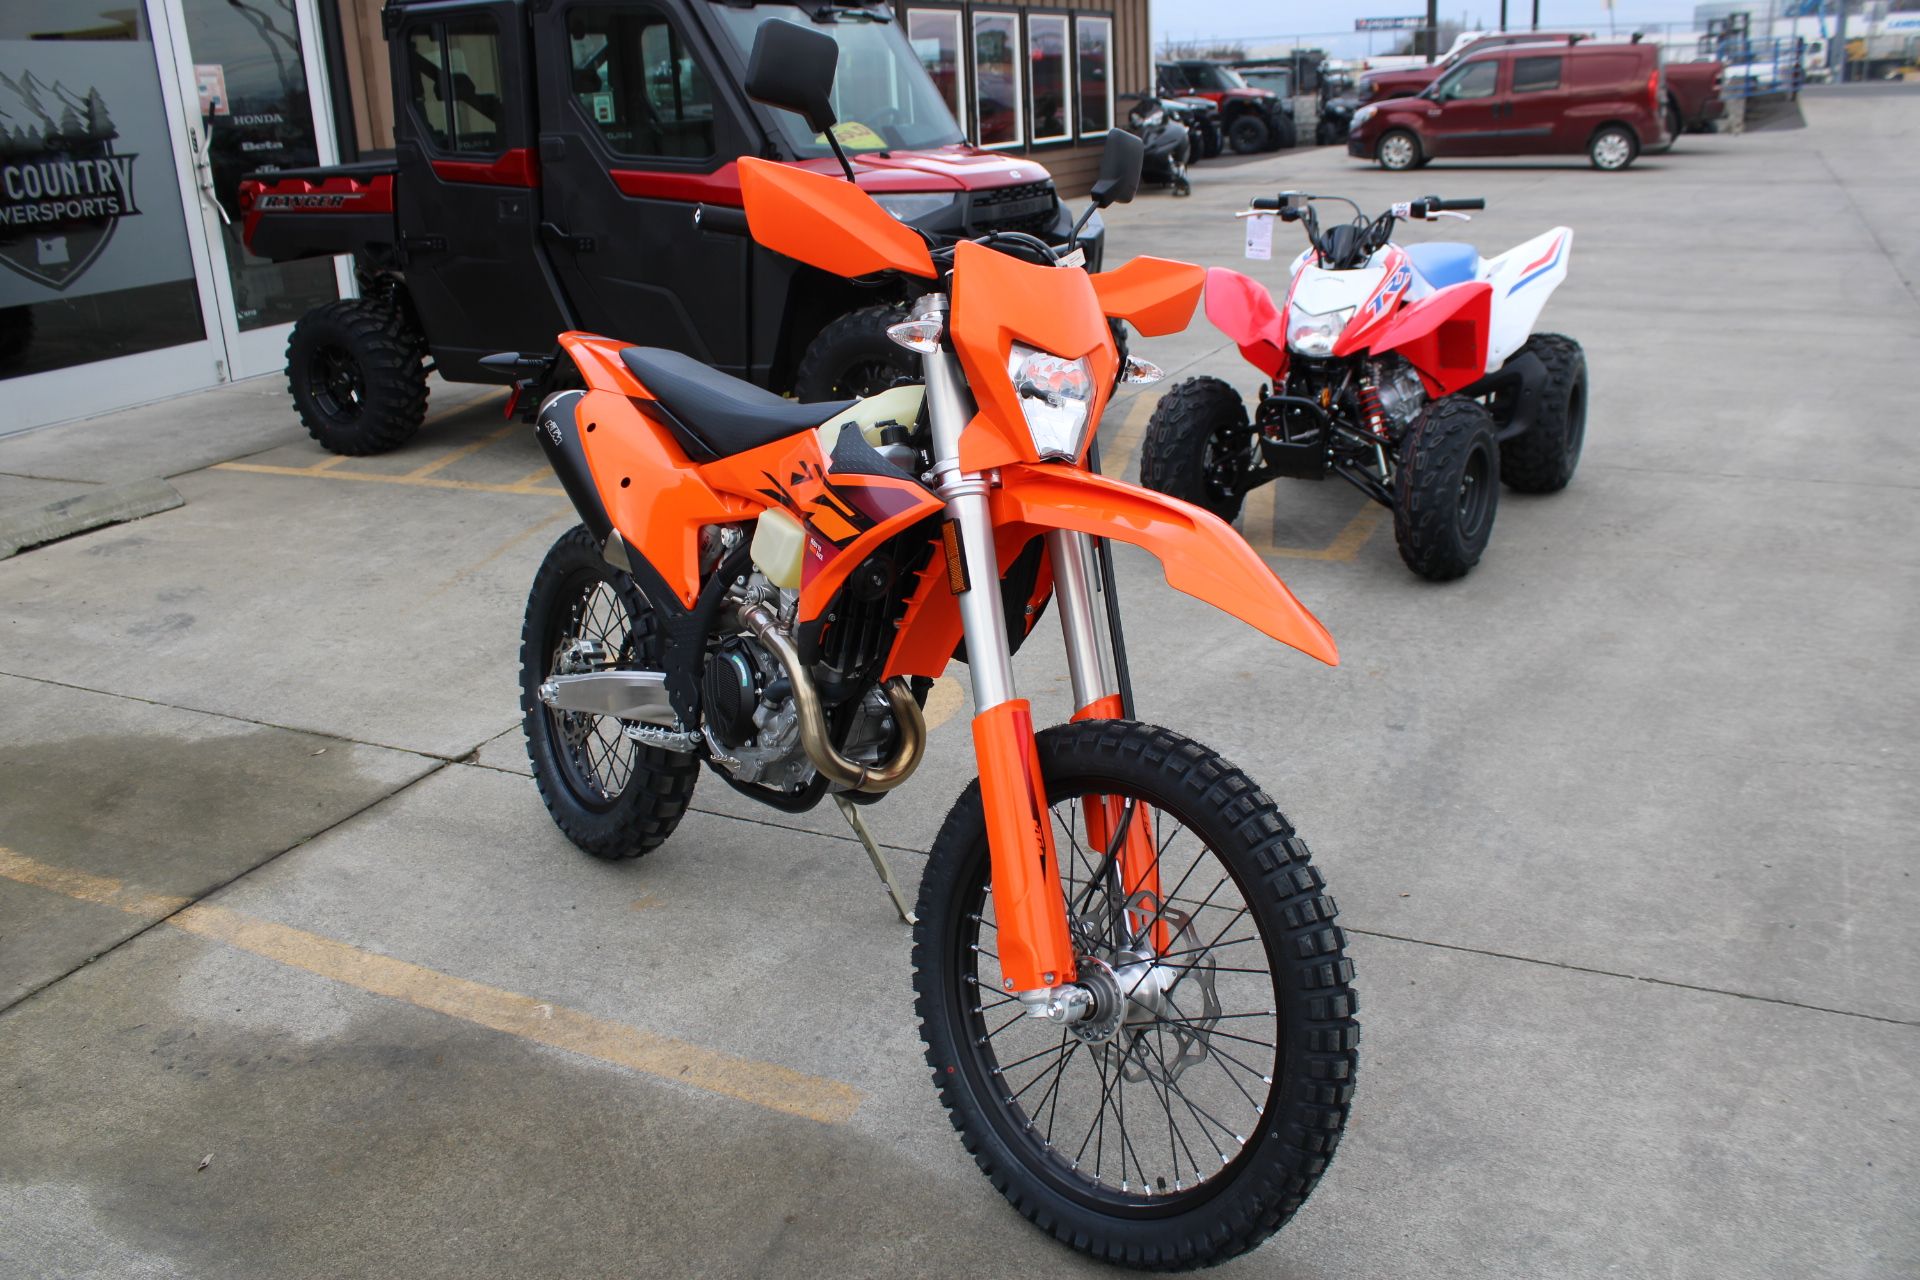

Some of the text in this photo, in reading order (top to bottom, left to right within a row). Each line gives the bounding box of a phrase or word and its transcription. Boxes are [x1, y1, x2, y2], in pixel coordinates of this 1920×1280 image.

[233, 113, 284, 125] HONDA
[241, 141, 284, 151] Beta
[4, 157, 136, 213] COUNTRY
[262, 195, 344, 208] RANGER
[544, 419, 563, 446] KTM
